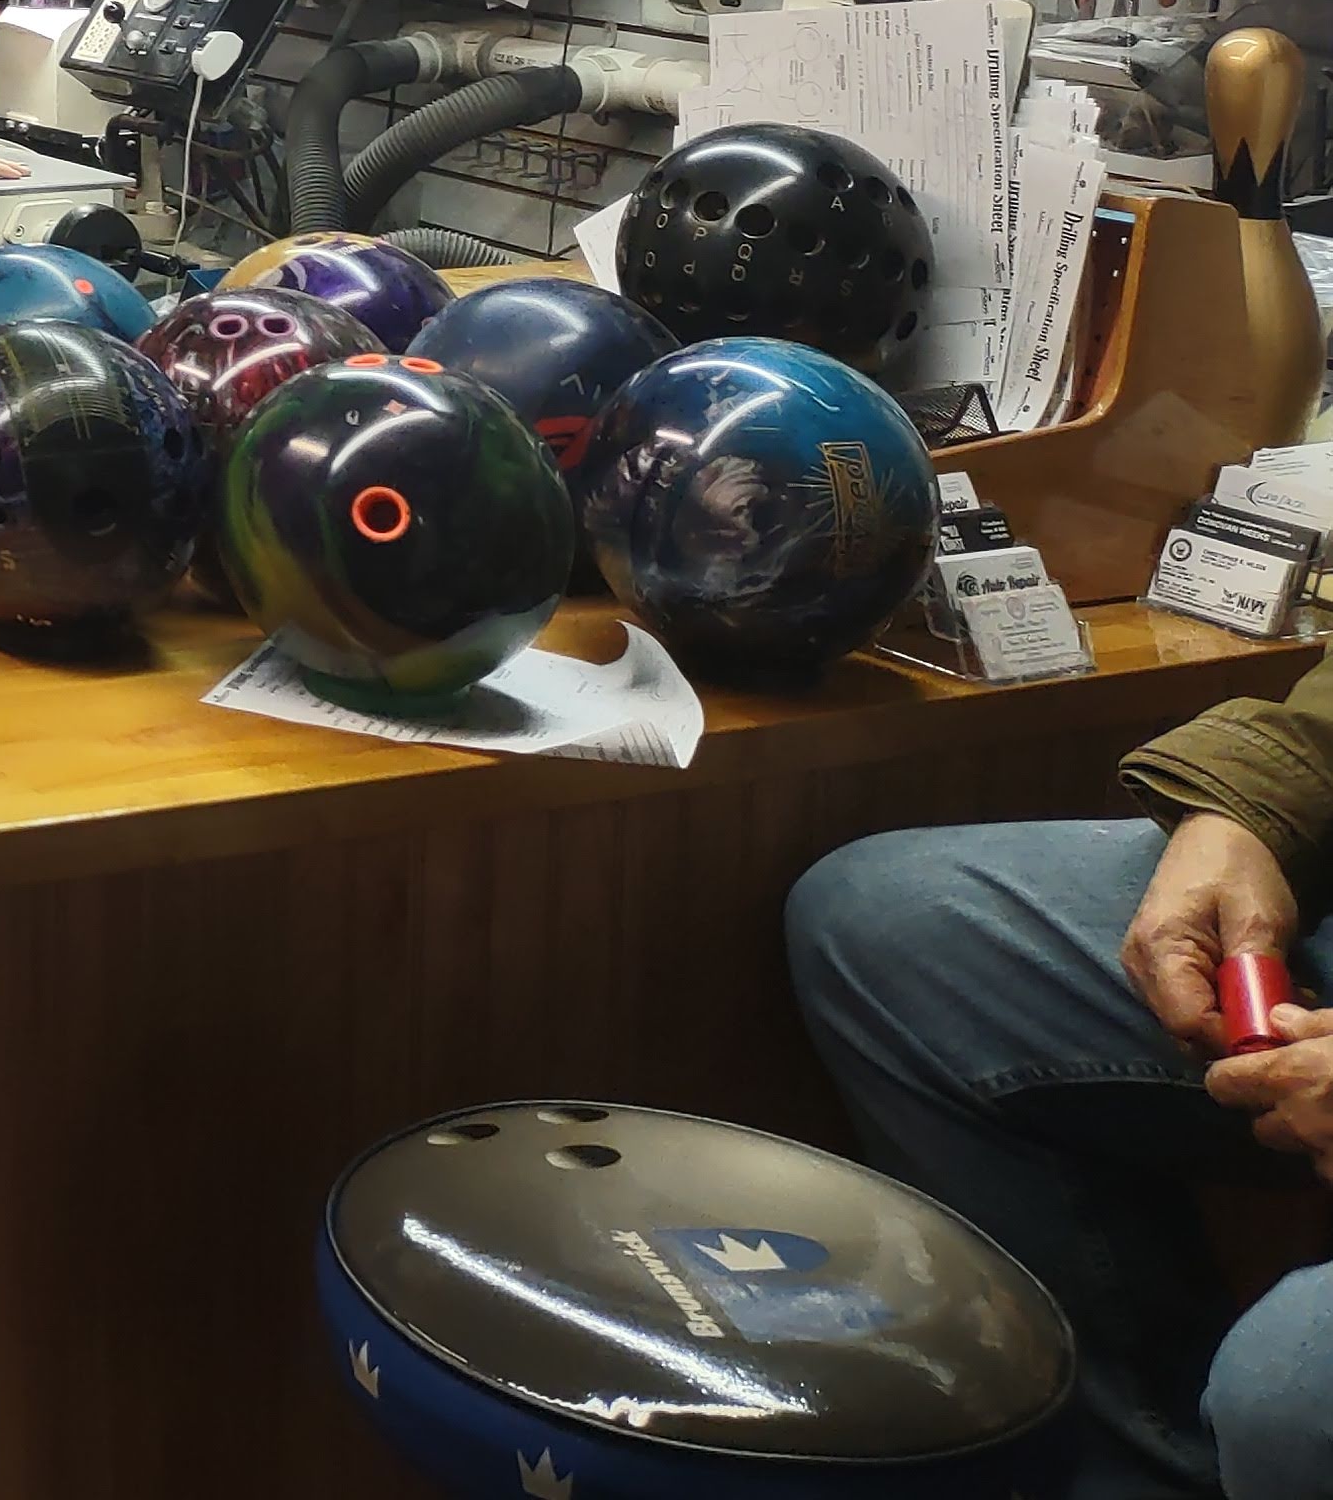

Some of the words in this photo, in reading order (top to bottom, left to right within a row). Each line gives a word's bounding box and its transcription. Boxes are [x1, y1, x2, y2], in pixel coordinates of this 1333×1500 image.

[986, 49, 1001, 99] Drilling
[989, 103, 1004, 191] Specification
[831, 196, 846, 213] A
[990, 193, 1004, 234] Sheet
[1056, 211, 1084, 259] Drilling
[1039, 261, 1068, 344] Specification
[1025, 345, 1050, 382] Sheet
[610, 1229, 726, 1338] Brunswick
